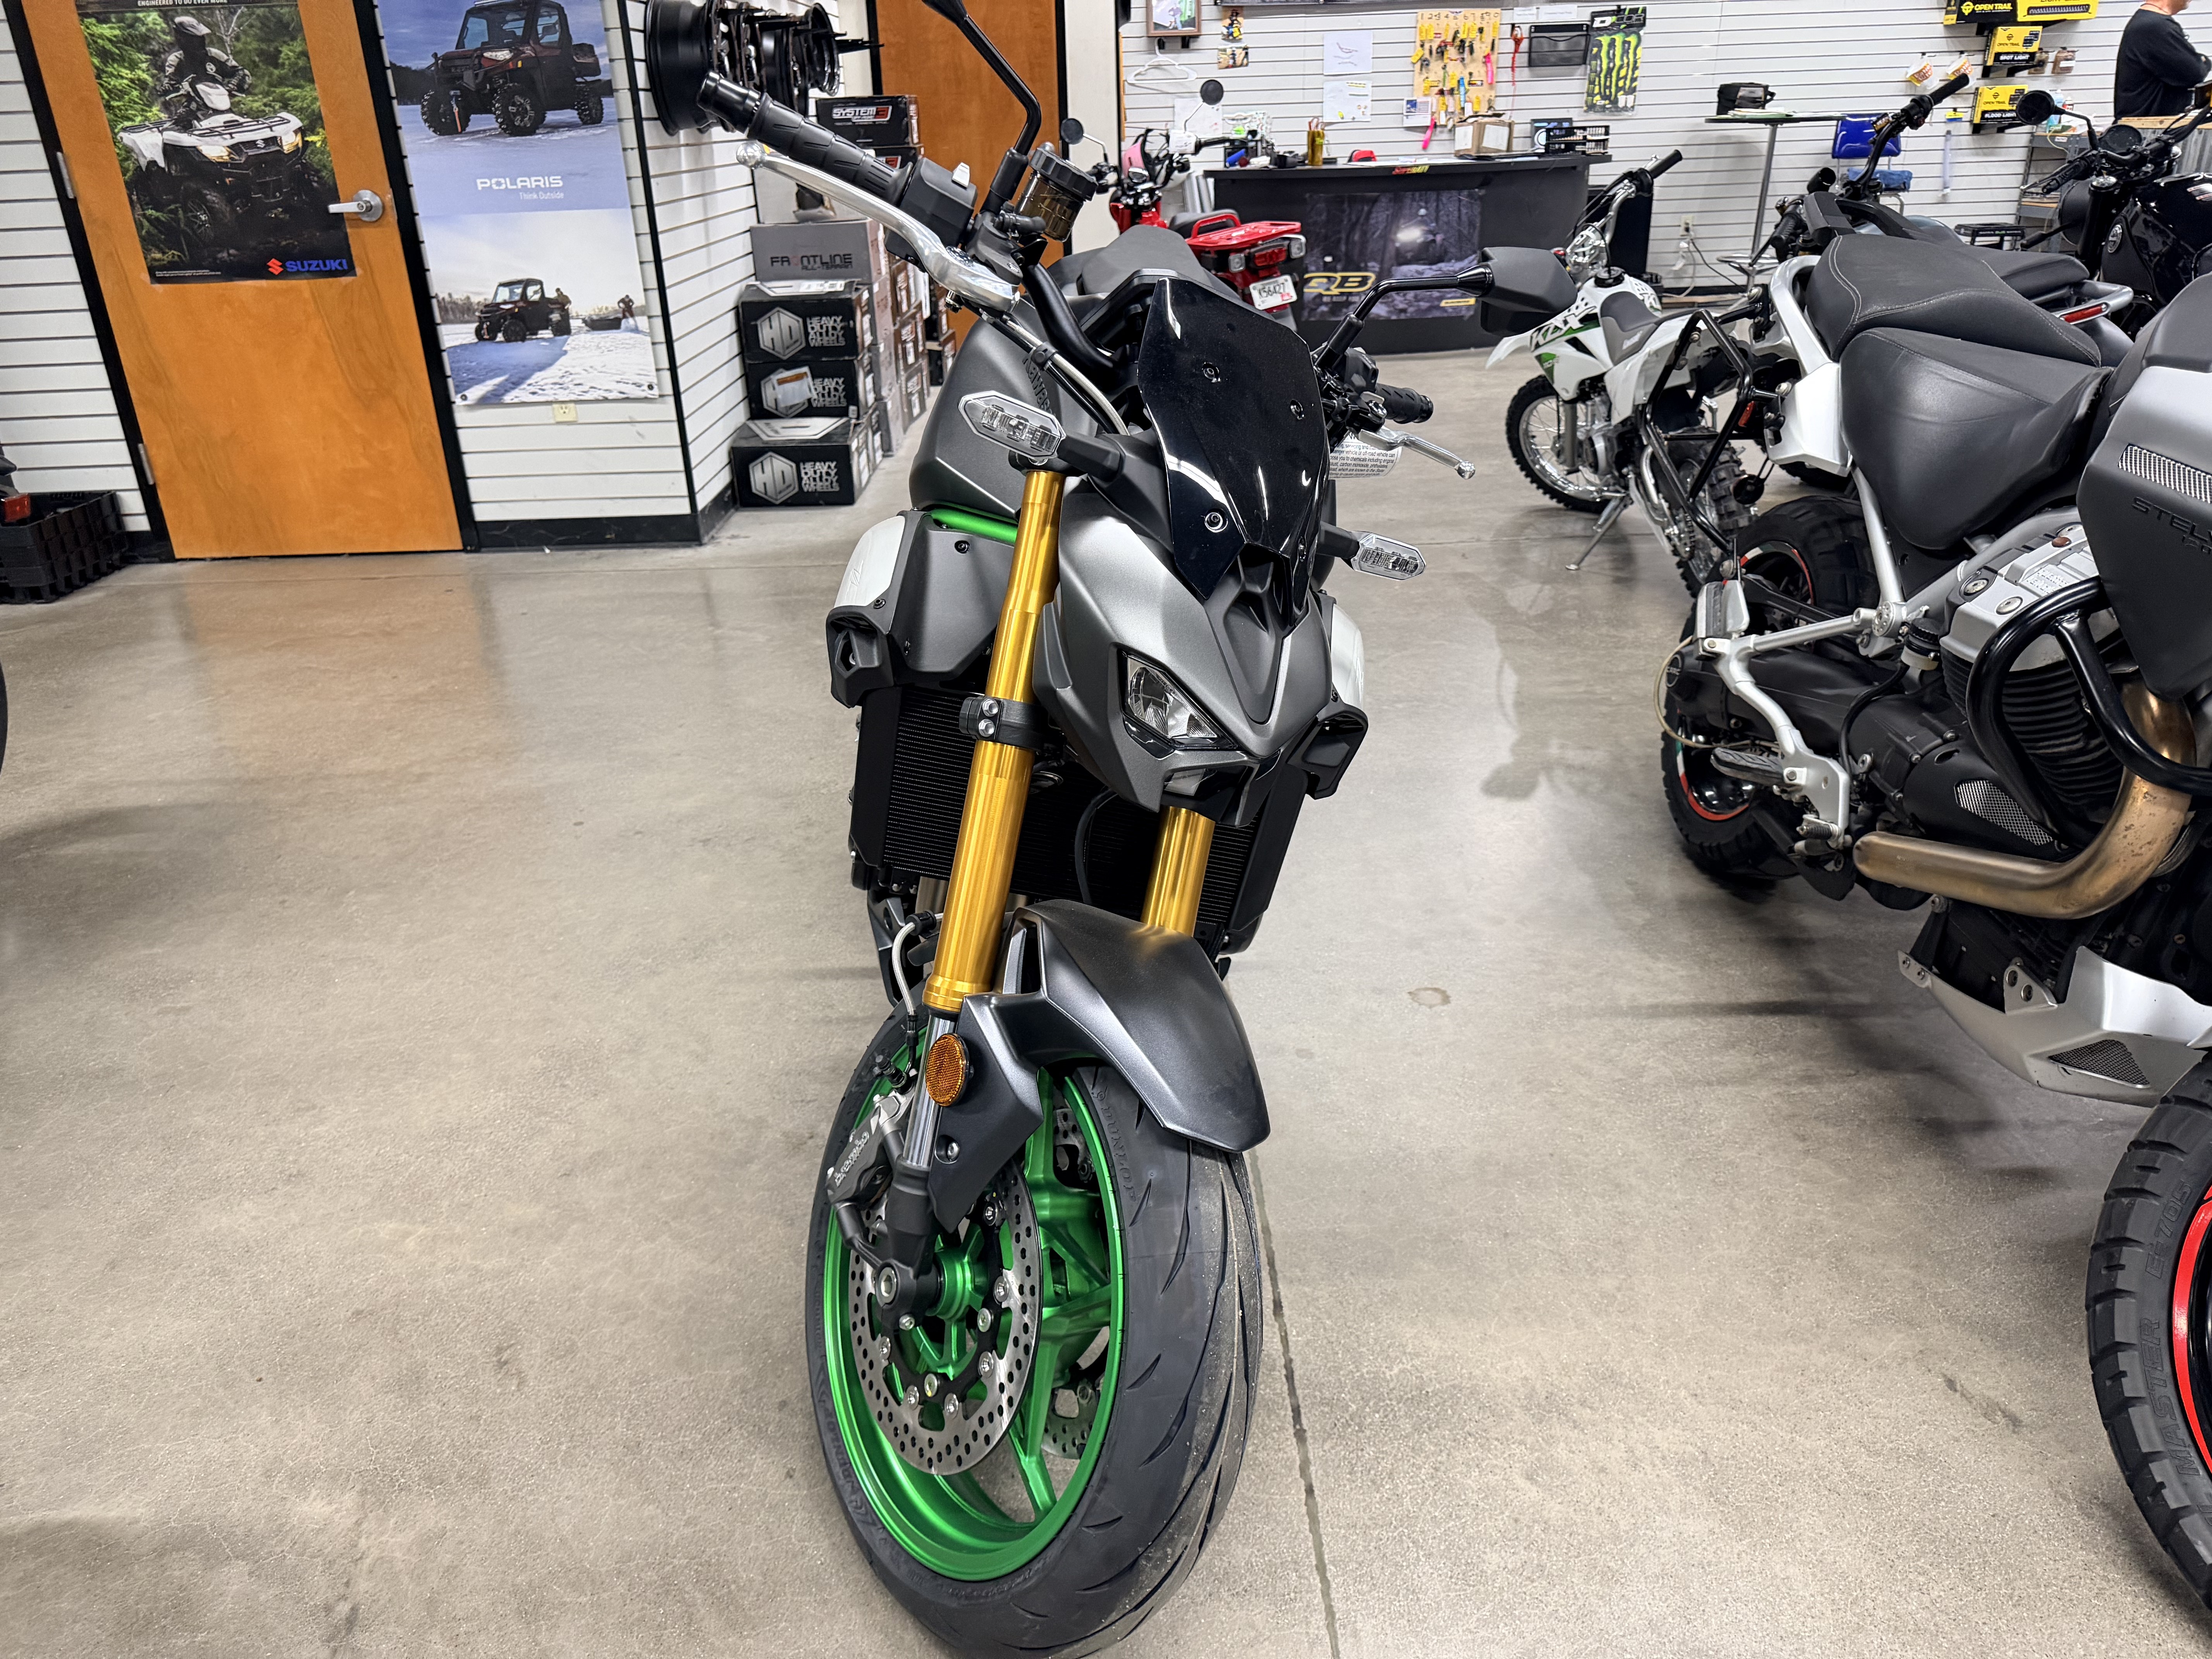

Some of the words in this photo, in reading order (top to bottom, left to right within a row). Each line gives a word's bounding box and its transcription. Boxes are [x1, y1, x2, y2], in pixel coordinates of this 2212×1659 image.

[476, 176, 563, 190] POLARIS
[285, 259, 348, 271] SUZUKI
[806, 316, 842, 326] HEAVY
[808, 323, 843, 333] DUTY
[809, 338, 846, 347] WHEELS
[800, 461, 836, 471] HEAVY
[801, 469, 837, 478] DUTY
[803, 483, 840, 492] WHEELS
[834, 1131, 869, 1187] brembo
[1101, 1106, 1136, 1202] DUNLOP
[2145, 1178, 2192, 1279] E-705
[2140, 1317, 2200, 1475] MASTER
